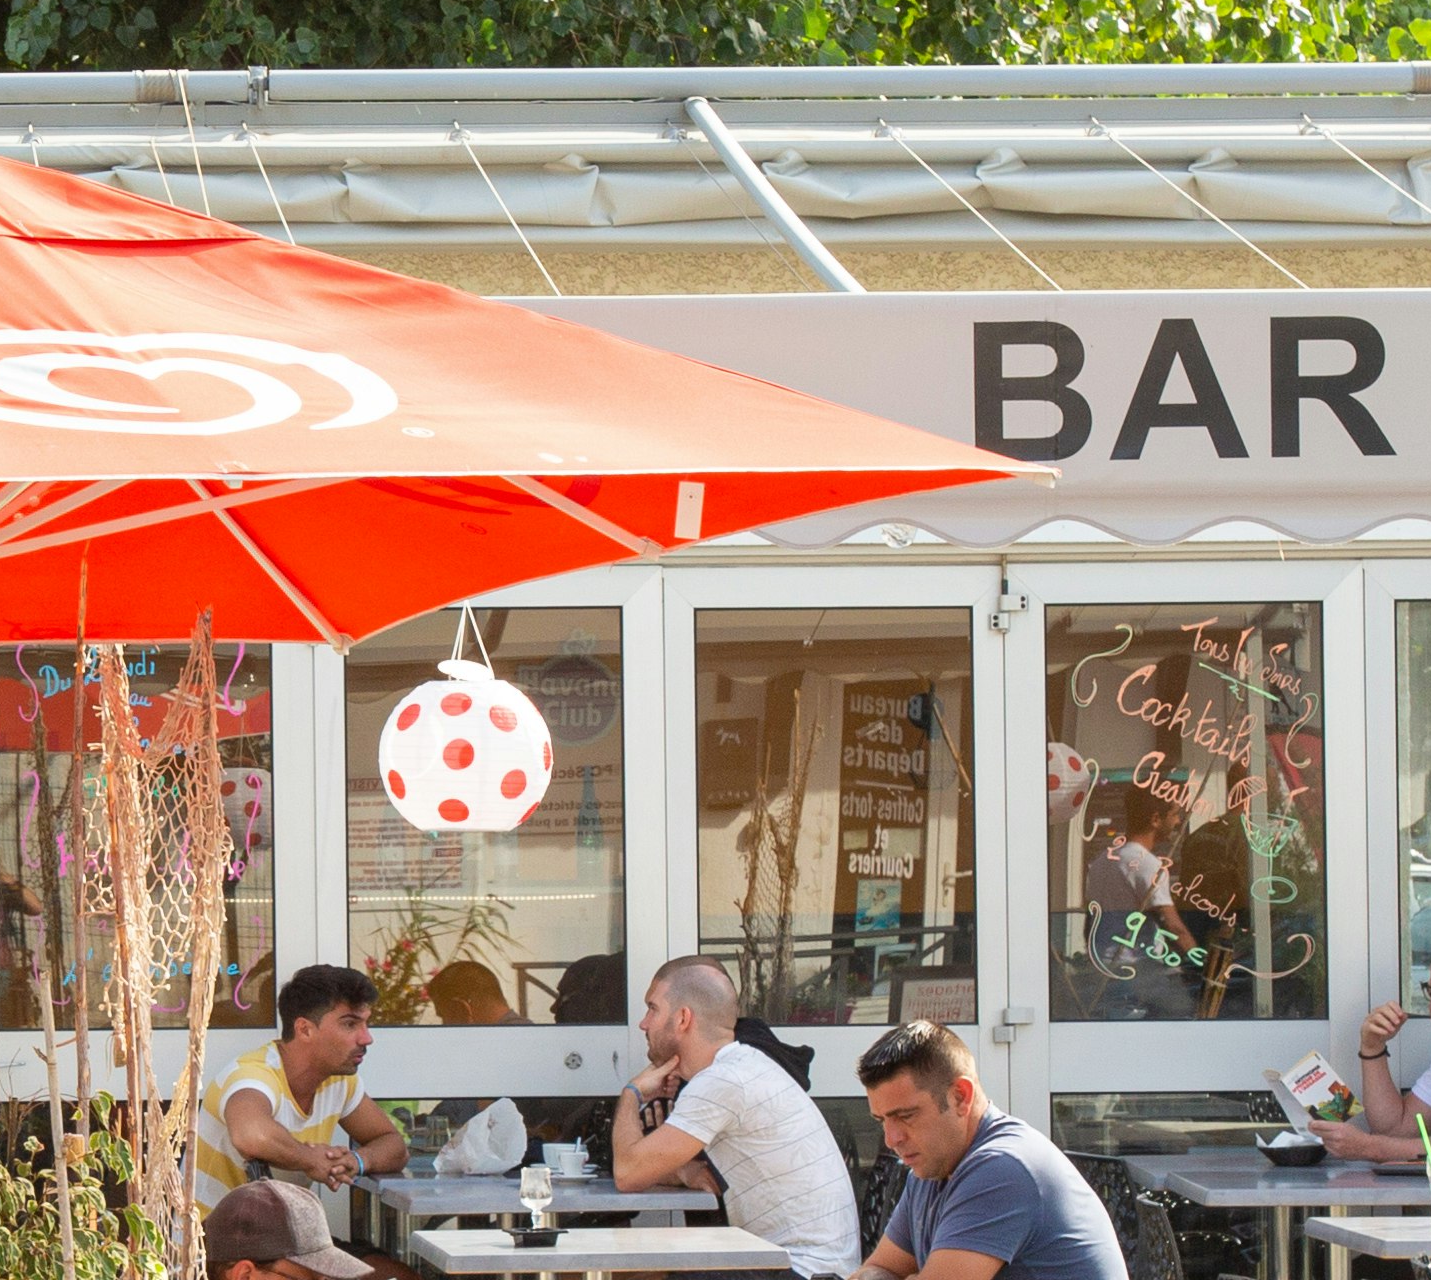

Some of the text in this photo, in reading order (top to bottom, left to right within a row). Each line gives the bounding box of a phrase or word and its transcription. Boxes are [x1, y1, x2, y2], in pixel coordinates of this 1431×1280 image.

[973, 315, 1397, 462] BAR
[543, 701, 602, 727] Club
[1117, 665, 1258, 767] Cocktails
